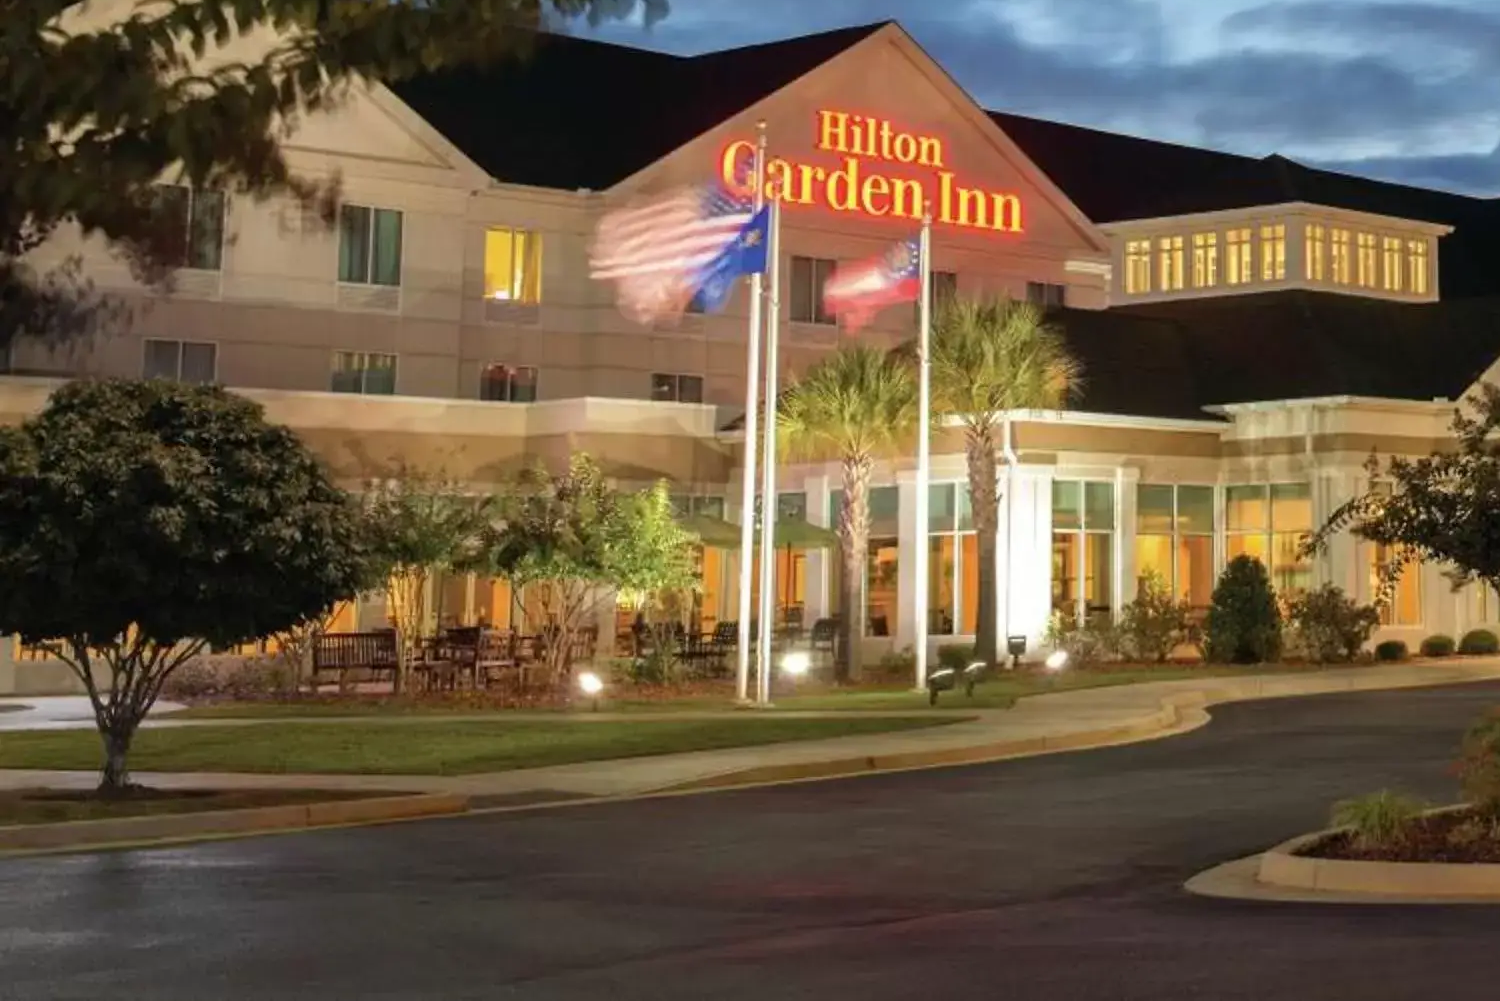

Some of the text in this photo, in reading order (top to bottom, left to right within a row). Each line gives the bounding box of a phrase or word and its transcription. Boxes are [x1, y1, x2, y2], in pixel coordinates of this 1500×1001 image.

[817, 109, 944, 167] Hilton
[722, 140, 1025, 232] Garden Inn
